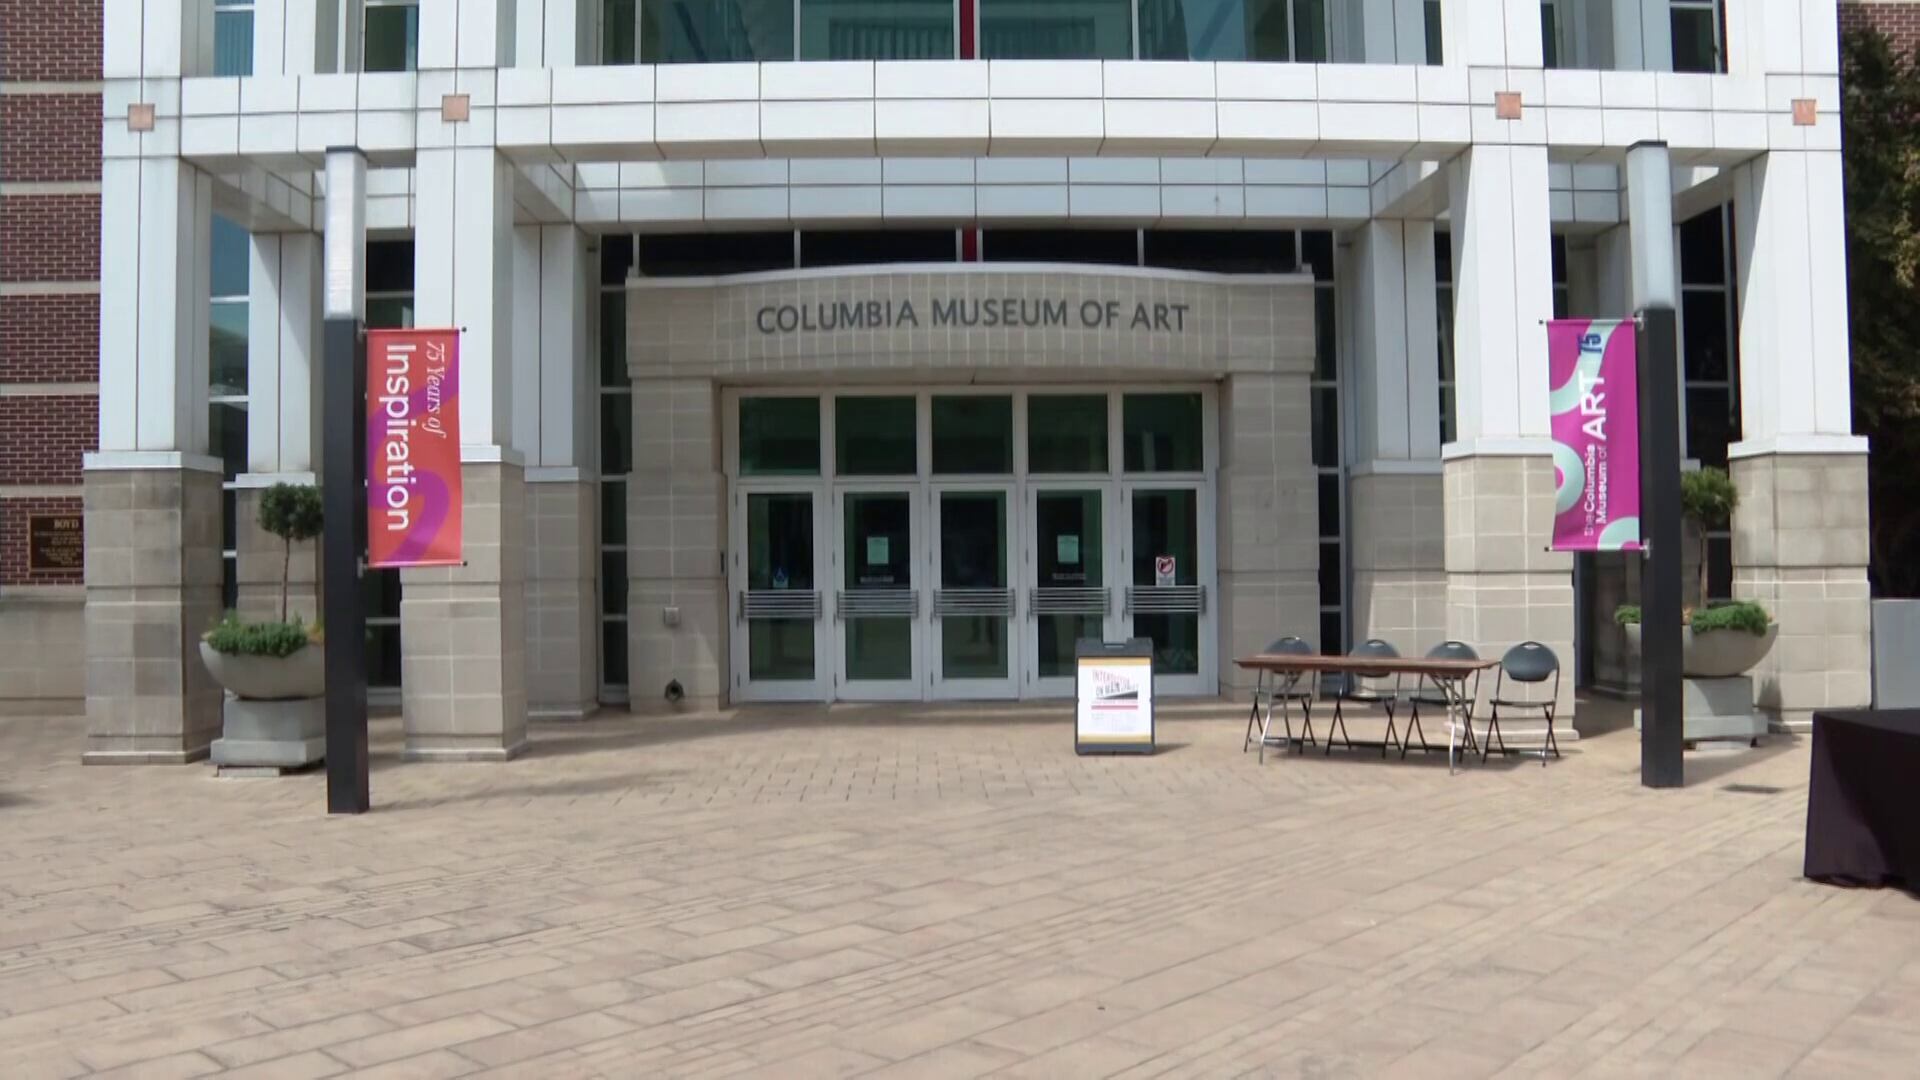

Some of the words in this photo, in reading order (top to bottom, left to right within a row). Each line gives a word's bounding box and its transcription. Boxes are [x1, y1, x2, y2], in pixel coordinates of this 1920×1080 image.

[757, 300, 919, 333] COLUMBIA
[932, 299, 1067, 327] MUSEUM
[1079, 301, 1120, 328] OF
[1130, 304, 1189, 332] ART
[426, 341, 446, 364] 75
[1577, 333, 1602, 355] 75
[426, 366, 445, 413] Years
[1579, 370, 1607, 441] ART
[379, 344, 417, 531] Inspiration
[423, 416, 446, 440] of
[1598, 445, 1607, 460] of
[1584, 444, 1596, 512] Columbia
[1596, 462, 1607, 525] Museum
